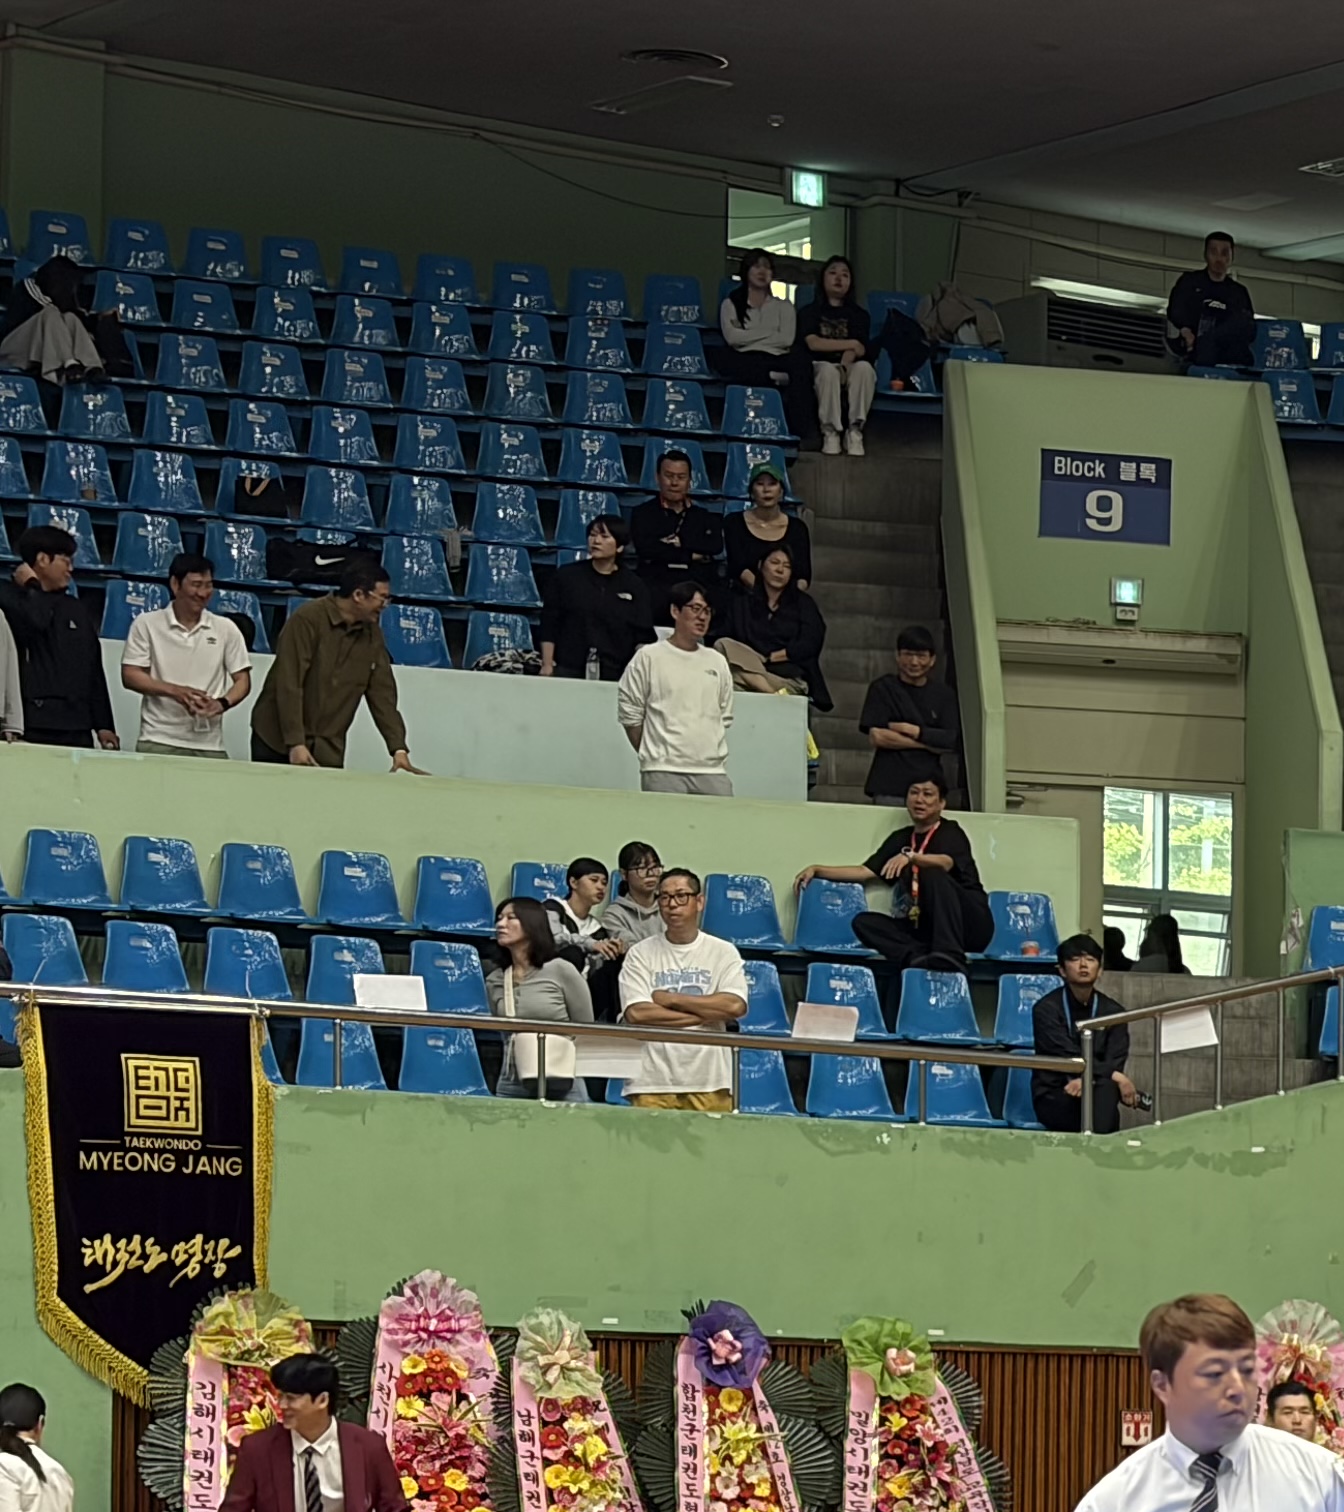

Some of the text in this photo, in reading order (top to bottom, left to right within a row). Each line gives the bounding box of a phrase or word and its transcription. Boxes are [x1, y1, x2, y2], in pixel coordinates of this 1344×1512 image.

[1054, 456, 1157, 484] Block 블록
[1085, 489, 1124, 532] 9
[124, 1136, 202, 1152] TAEKWONDO
[79, 1151, 244, 1177] MYEONG JANG
